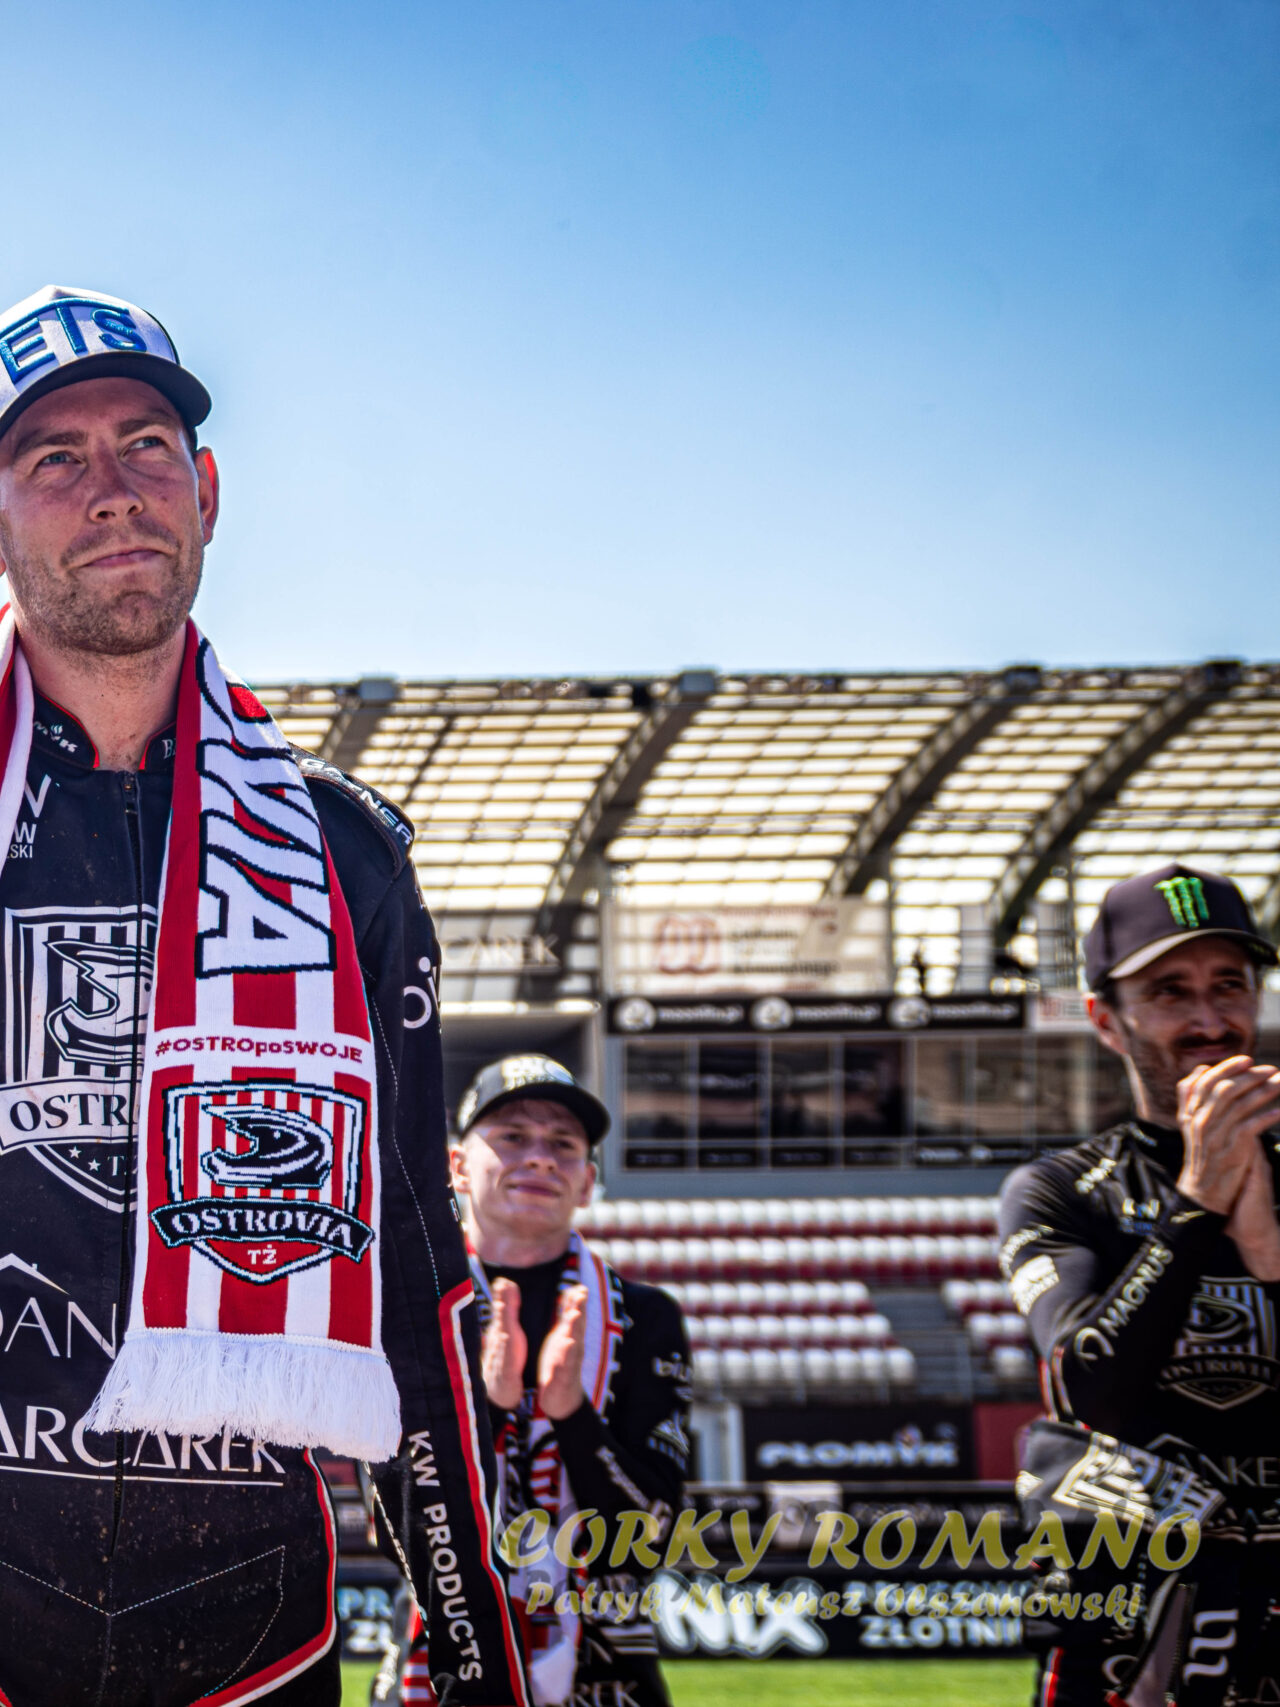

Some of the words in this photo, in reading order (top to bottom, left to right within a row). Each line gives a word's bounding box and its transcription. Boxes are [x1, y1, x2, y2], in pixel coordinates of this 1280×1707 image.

[7, 843, 34, 859] SKI
[154, 1035, 363, 1064] #OSTROpoSWOJE
[171, 1207, 354, 1249] OSTROVIA
[247, 1243, 278, 1265] TŻ
[408, 1431, 440, 1487] KW
[424, 1502, 483, 1682] PRODUCTS
